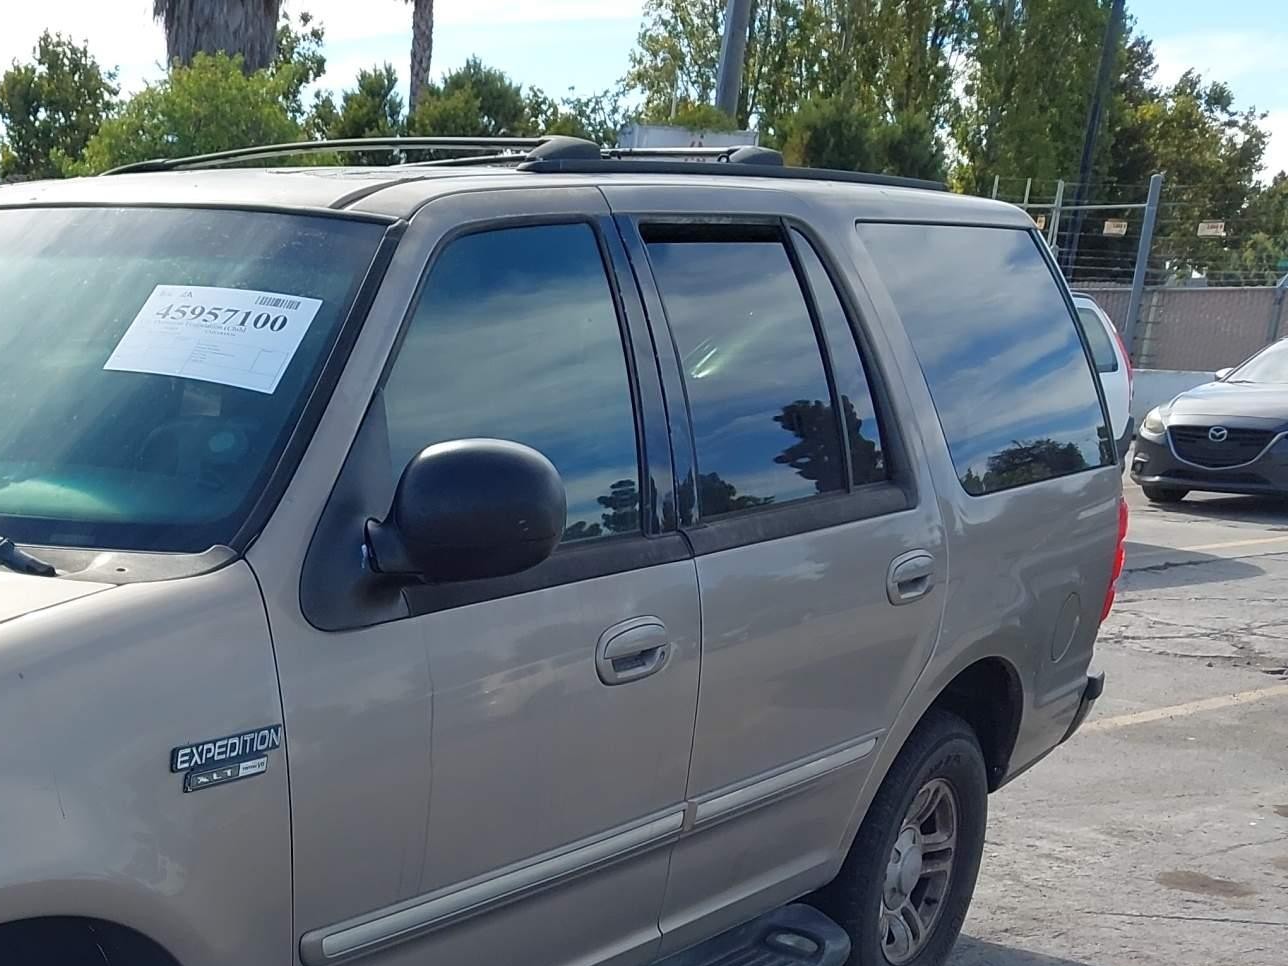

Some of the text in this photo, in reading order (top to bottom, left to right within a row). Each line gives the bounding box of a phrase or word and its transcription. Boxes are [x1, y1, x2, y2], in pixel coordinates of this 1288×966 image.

[155, 303, 288, 333] 45957100
[176, 727, 282, 770] EXPEDITION
[197, 769, 233, 784] XLT
